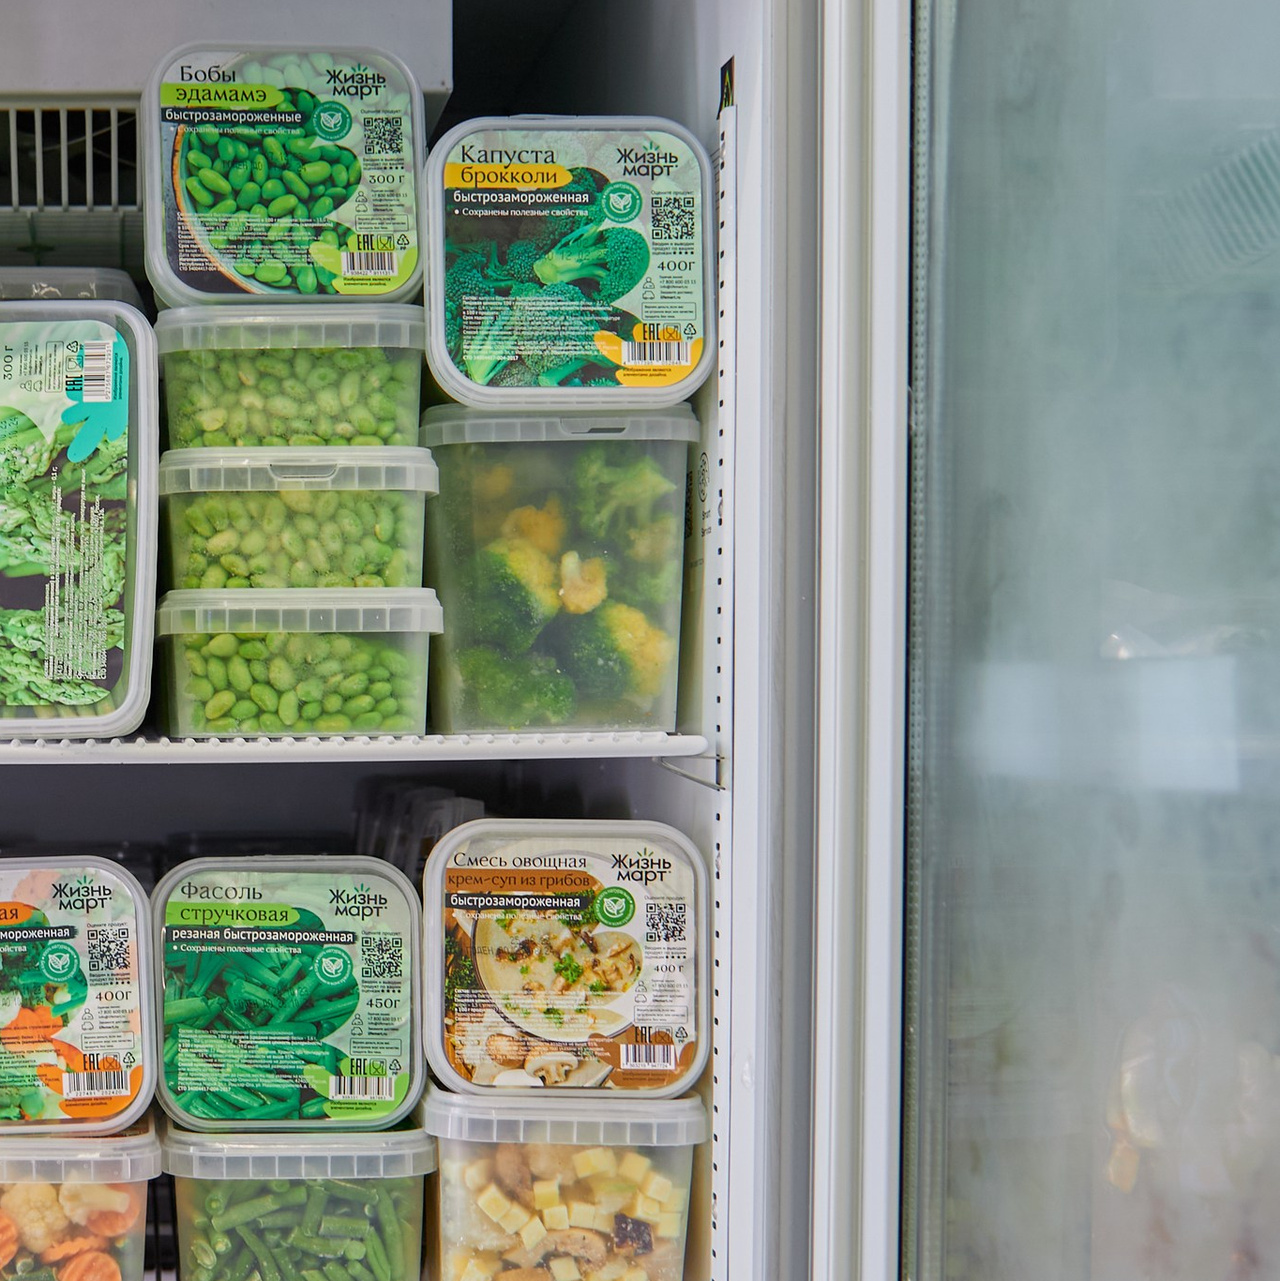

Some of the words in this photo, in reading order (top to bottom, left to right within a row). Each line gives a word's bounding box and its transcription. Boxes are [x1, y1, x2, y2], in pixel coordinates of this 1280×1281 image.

[180, 65, 236, 82] Бобы
[326, 69, 386, 85] Жизнь
[176, 88, 267, 103] эдамамэ
[332, 84, 381, 100] март
[165, 109, 302, 123] быстрозамороженные
[263, 127, 300, 135] свойства
[461, 145, 556, 169] Капуста
[617, 148, 679, 164] Жизнь
[369, 174, 395, 184] 300
[461, 166, 557, 188] брокколи
[623, 164, 674, 180] март
[453, 190, 589, 205] быстрозамороженная
[462, 207, 509, 217] Сохранены
[510, 208, 550, 216] полезные
[551, 208, 588, 216] свойства
[357, 234, 374, 251] EAC
[657, 260, 695, 271] 400г
[642, 323, 661, 340] EAC
[3, 355, 13, 380] 300
[65, 375, 82, 391] EAC
[454, 852, 507, 867] Смесь
[512, 857, 587, 870] овощная
[611, 853, 672, 869] Жизнь
[448, 875, 516, 888] крем-суп
[520, 877, 536, 885] из
[540, 874, 590, 888] грибов
[617, 869, 667, 885] март
[52, 883, 112, 899] Жизнь
[181, 882, 262, 900] Фасоль
[329, 889, 388, 905] Жизнь
[59, 898, 108, 913] март
[450, 894, 580, 908] быстрозамороженная
[180, 908, 288, 925] стручковая
[335, 905, 383, 920] март
[173, 929, 220, 941] резаная
[224, 929, 353, 942] быстрозамороженная
[180, 944, 225, 953] Сохранены
[266, 946, 301, 954] свойства
[653, 964, 675, 973] 400
[95, 990, 132, 1001] 400г
[366, 998, 400, 1009] 450г
[635, 1026, 653, 1043] EAC
[83, 1054, 100, 1070] EAC
[351, 1058, 367, 1075] EAC
